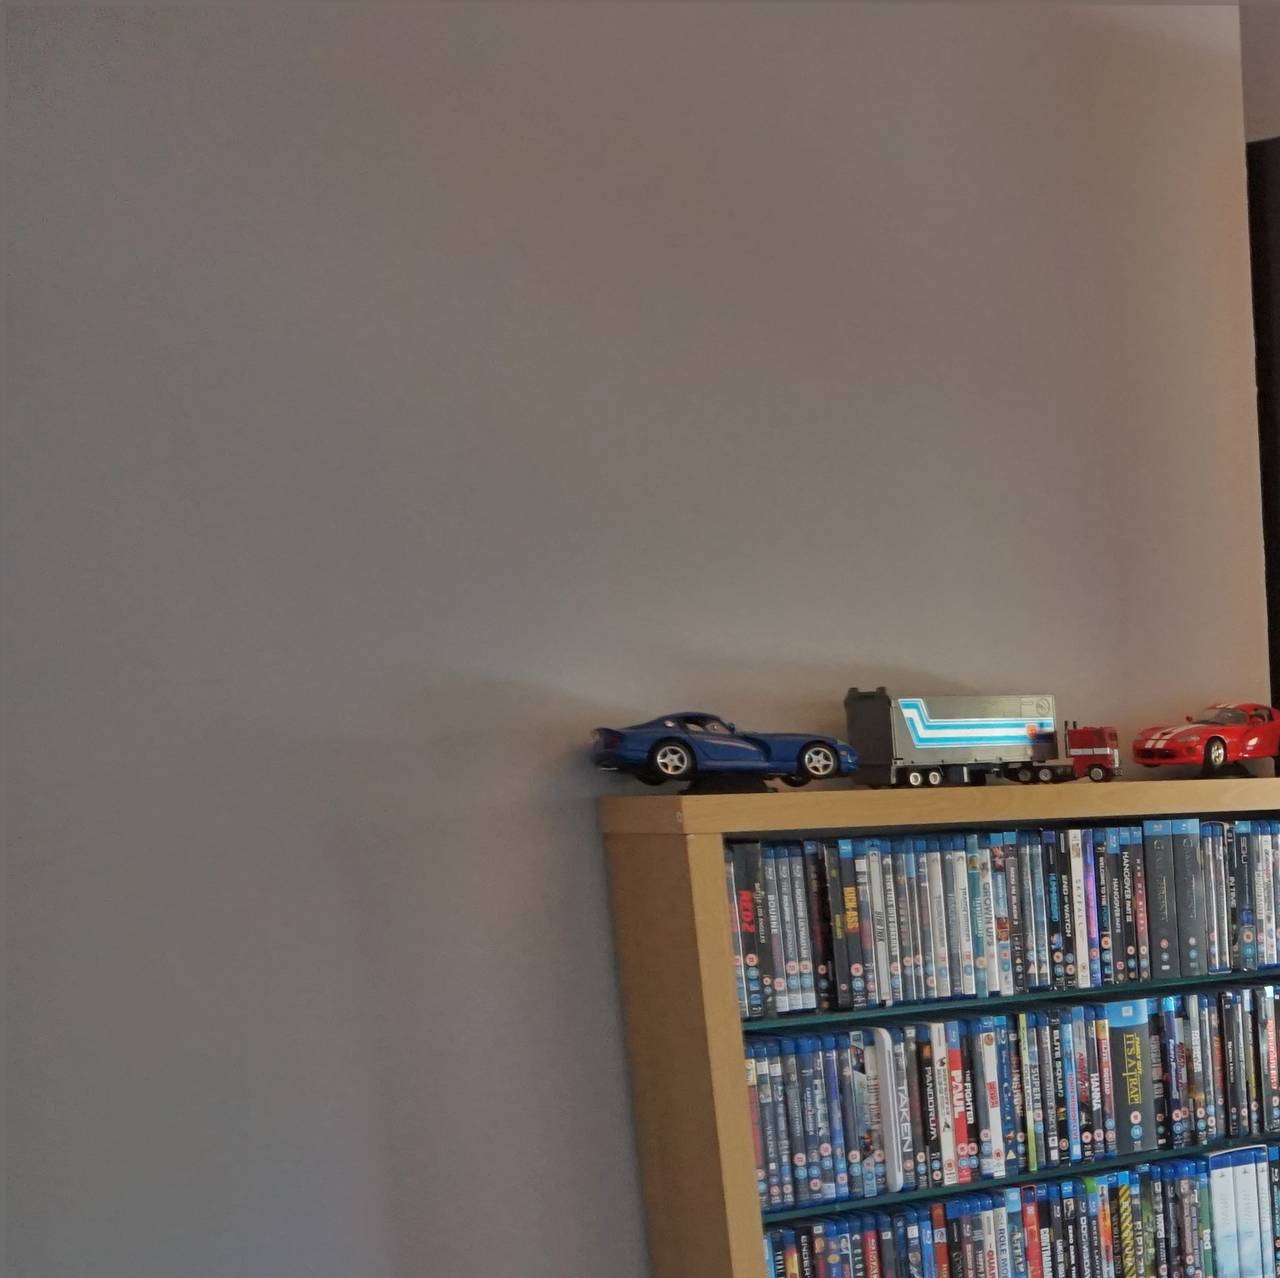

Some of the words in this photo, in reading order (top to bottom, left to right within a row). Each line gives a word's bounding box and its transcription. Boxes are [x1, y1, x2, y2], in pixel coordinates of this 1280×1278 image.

[1062, 875, 1070, 895] END
[1122, 851, 1132, 899] HANGOVER
[768, 895, 777, 934] BOURNE
[844, 887, 859, 929] KICK-ASS
[982, 882, 993, 925] GROWN
[1112, 878, 1120, 916] HANGOVER
[985, 927, 994, 946] UPS
[1064, 904, 1072, 937] WATCH
[1052, 1030, 1060, 1058] ELITE
[1126, 1034, 1136, 1056] IT'S
[951, 1069, 965, 1119] PAUL
[1031, 1068, 1040, 1100] SUPER
[1055, 1061, 1063, 1097] SQUAD
[1090, 1073, 1101, 1111] HANNA
[898, 1079, 913, 1153] TAKEN
[925, 1066, 937, 1140] PANDORUM
[965, 1083, 974, 1124] FIGHTER
[998, 1228, 1007, 1256] ROLE
[1203, 1229, 1212, 1250] ted
